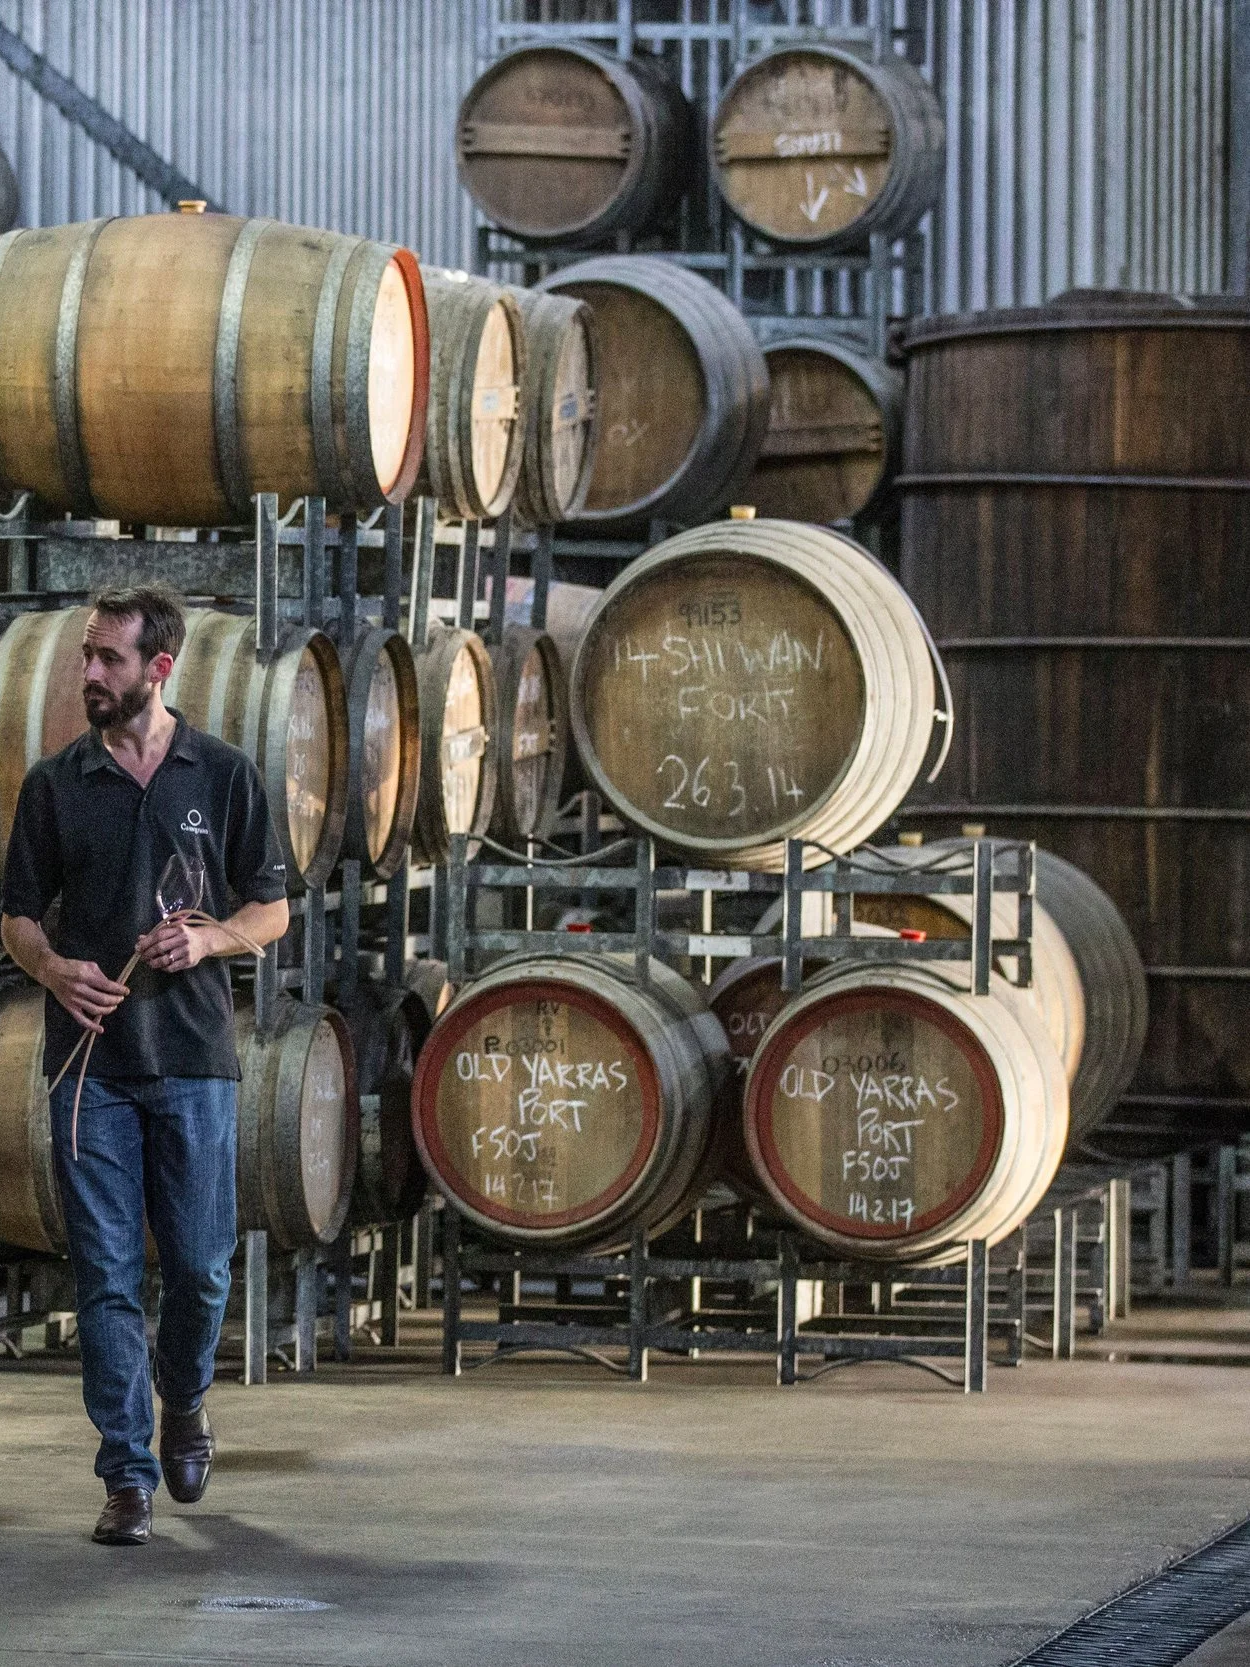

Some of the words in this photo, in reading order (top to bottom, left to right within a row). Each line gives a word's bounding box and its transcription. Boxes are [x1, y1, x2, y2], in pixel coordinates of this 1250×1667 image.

[456, 1052, 511, 1082] OLD
[522, 1053, 627, 1092] YARRAS
[780, 1064, 835, 1101] OLD
[850, 1073, 958, 1111] YARRAS
[519, 1088, 588, 1132] PORT
[857, 1108, 924, 1153] PORT
